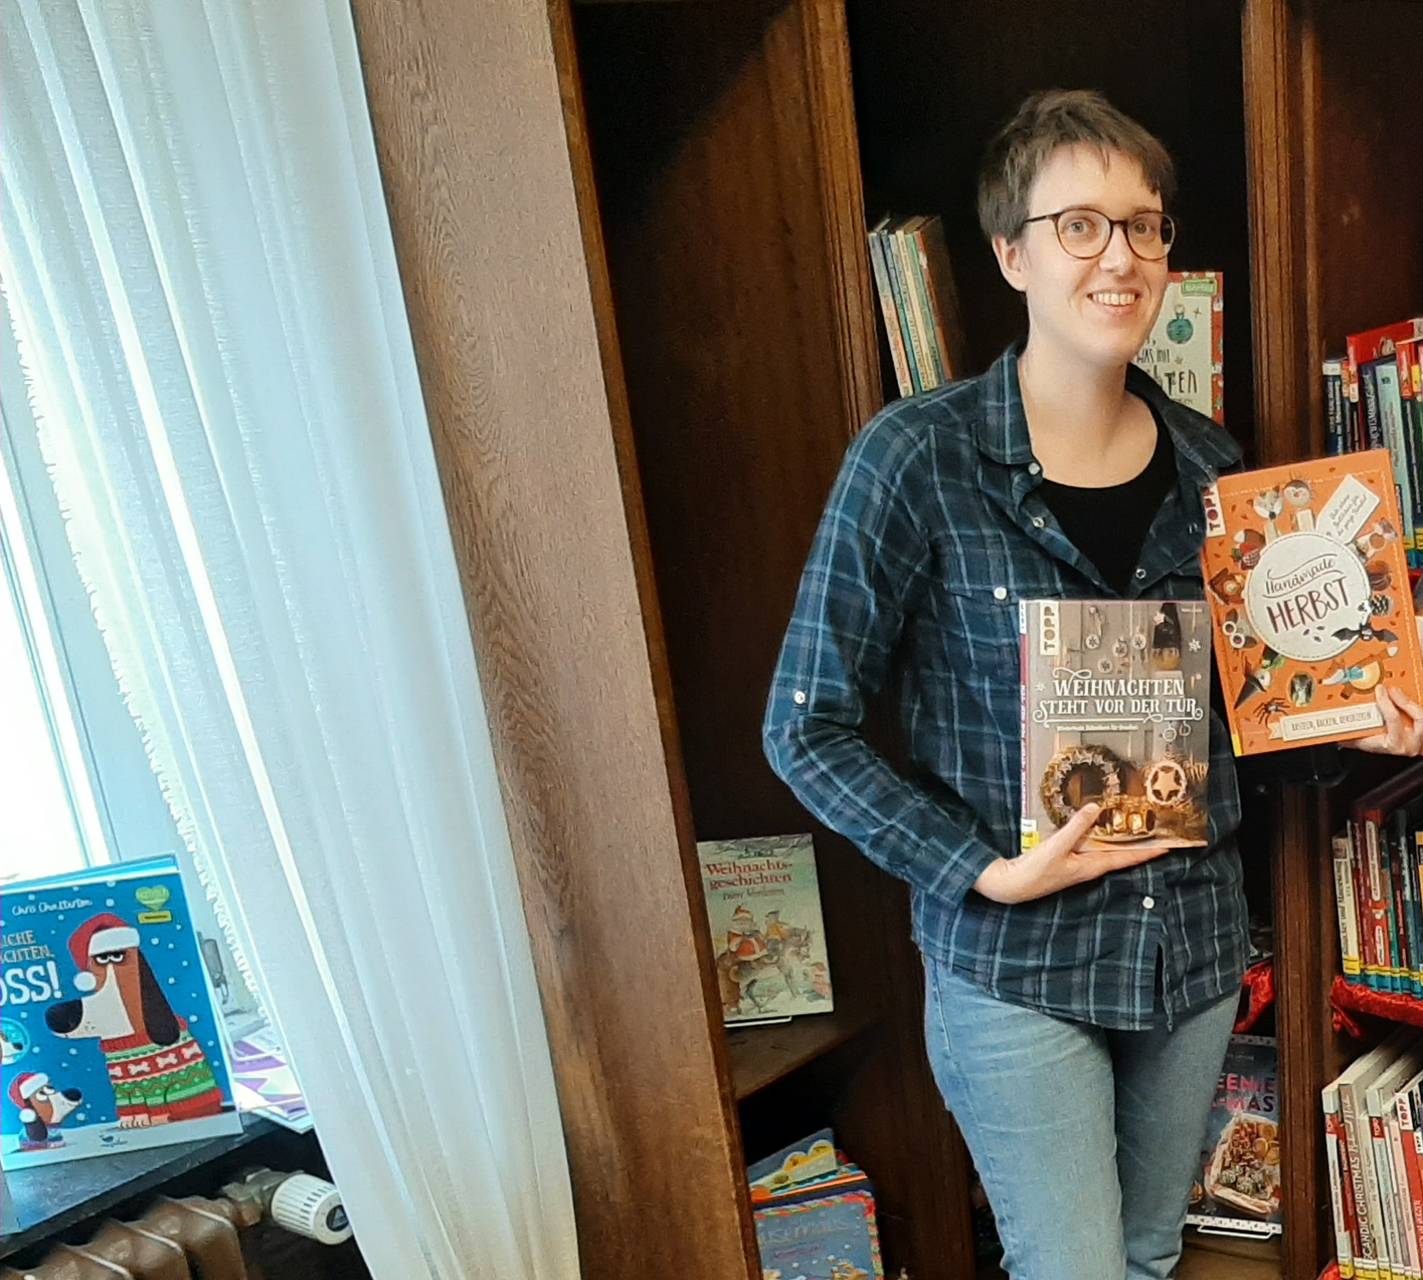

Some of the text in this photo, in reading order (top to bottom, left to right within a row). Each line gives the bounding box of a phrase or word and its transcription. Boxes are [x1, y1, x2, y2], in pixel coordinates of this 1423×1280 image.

[1204, 487, 1221, 532] TOPP
[1265, 557, 1337, 596] Handmade
[1267, 577, 1349, 634] HERBST
[1043, 606, 1057, 651] TOPP
[1053, 671, 1185, 697] WEIHNACHTEN
[1036, 697, 1201, 718] STEHT VOR DER TÜR
[706, 858, 793, 877] Weihnachts-
[709, 873, 792, 891] geschichten
[1397, 1097, 1409, 1126] TOPP
[1349, 1157, 1372, 1261] SCANDIC CHRISTMAS
